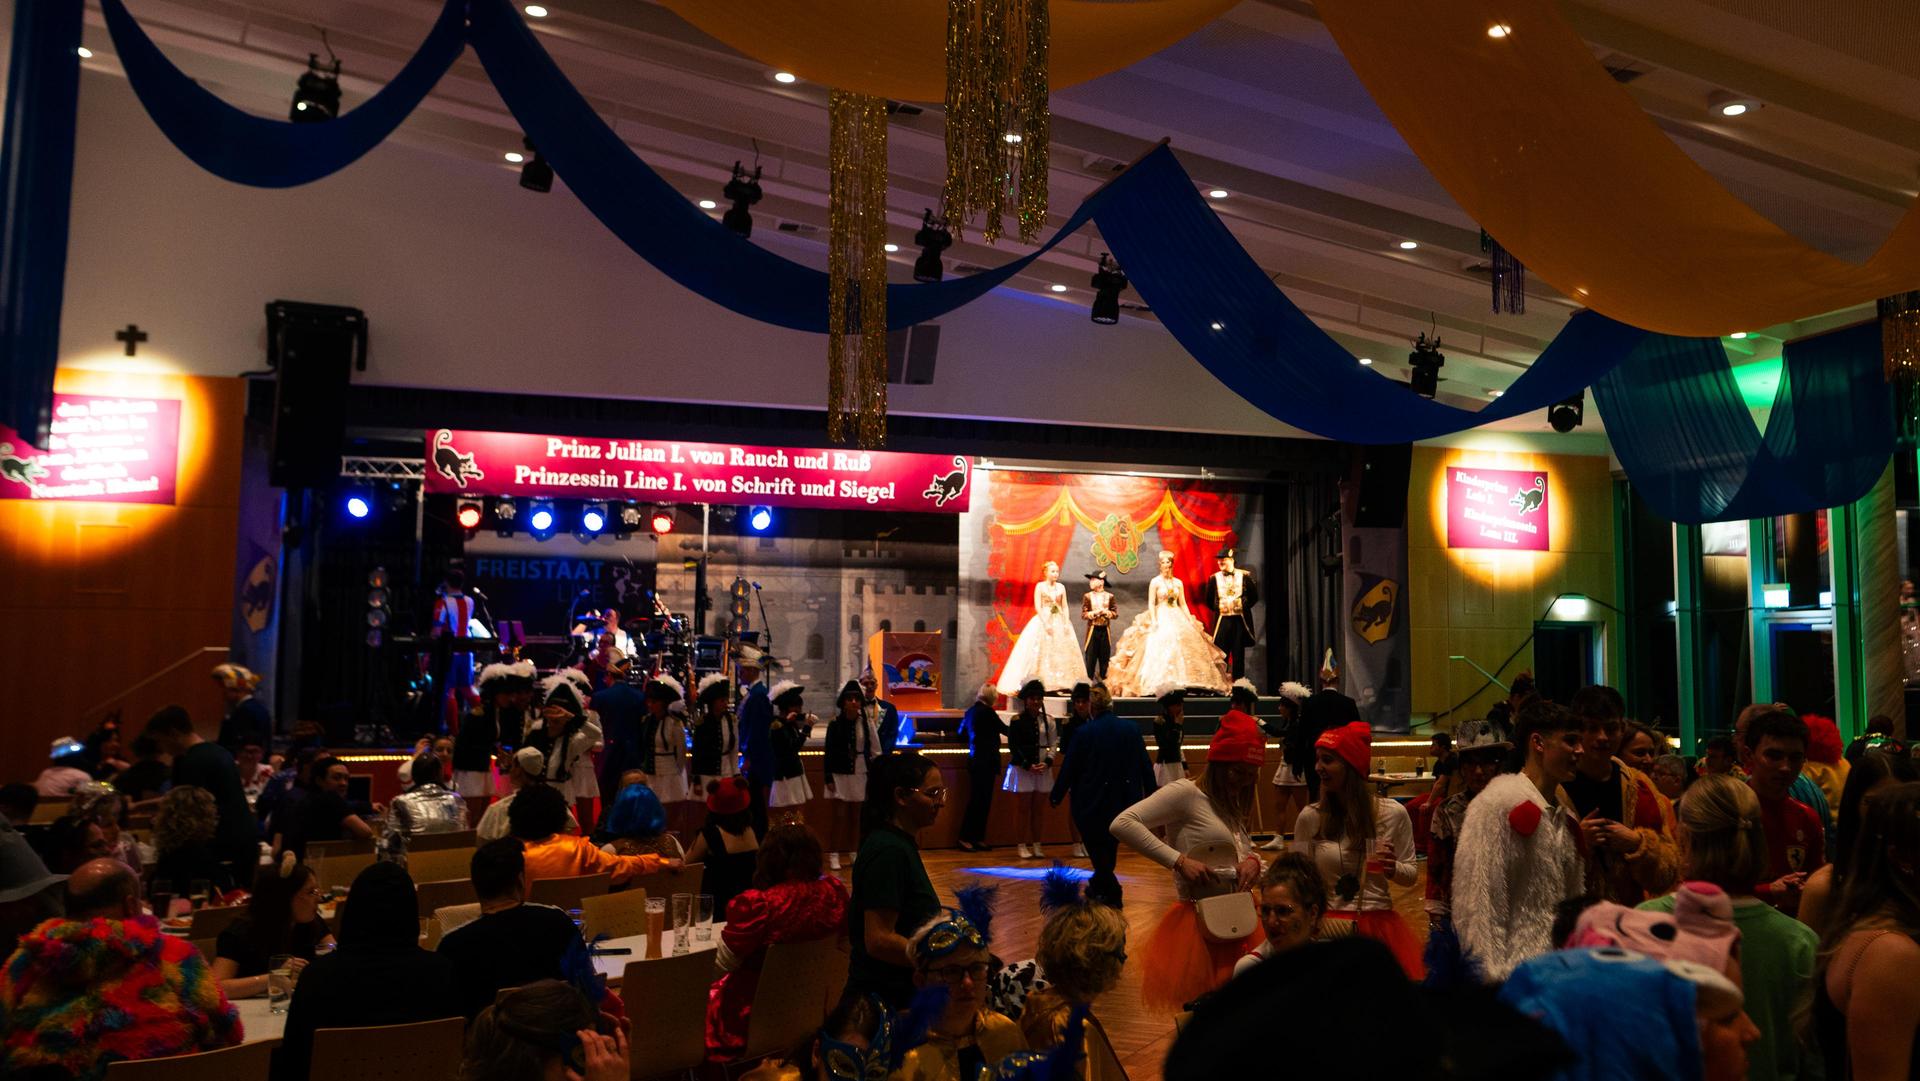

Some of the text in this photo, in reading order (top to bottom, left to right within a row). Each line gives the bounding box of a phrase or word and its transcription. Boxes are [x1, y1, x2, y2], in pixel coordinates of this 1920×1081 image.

[546, 438, 871, 472] Prinz Julian I. von Rauch und Ruß
[515, 465, 895, 503] Prinzessin Line I. von Schrift und Siegel
[476, 559, 604, 580] FREISTAAT
